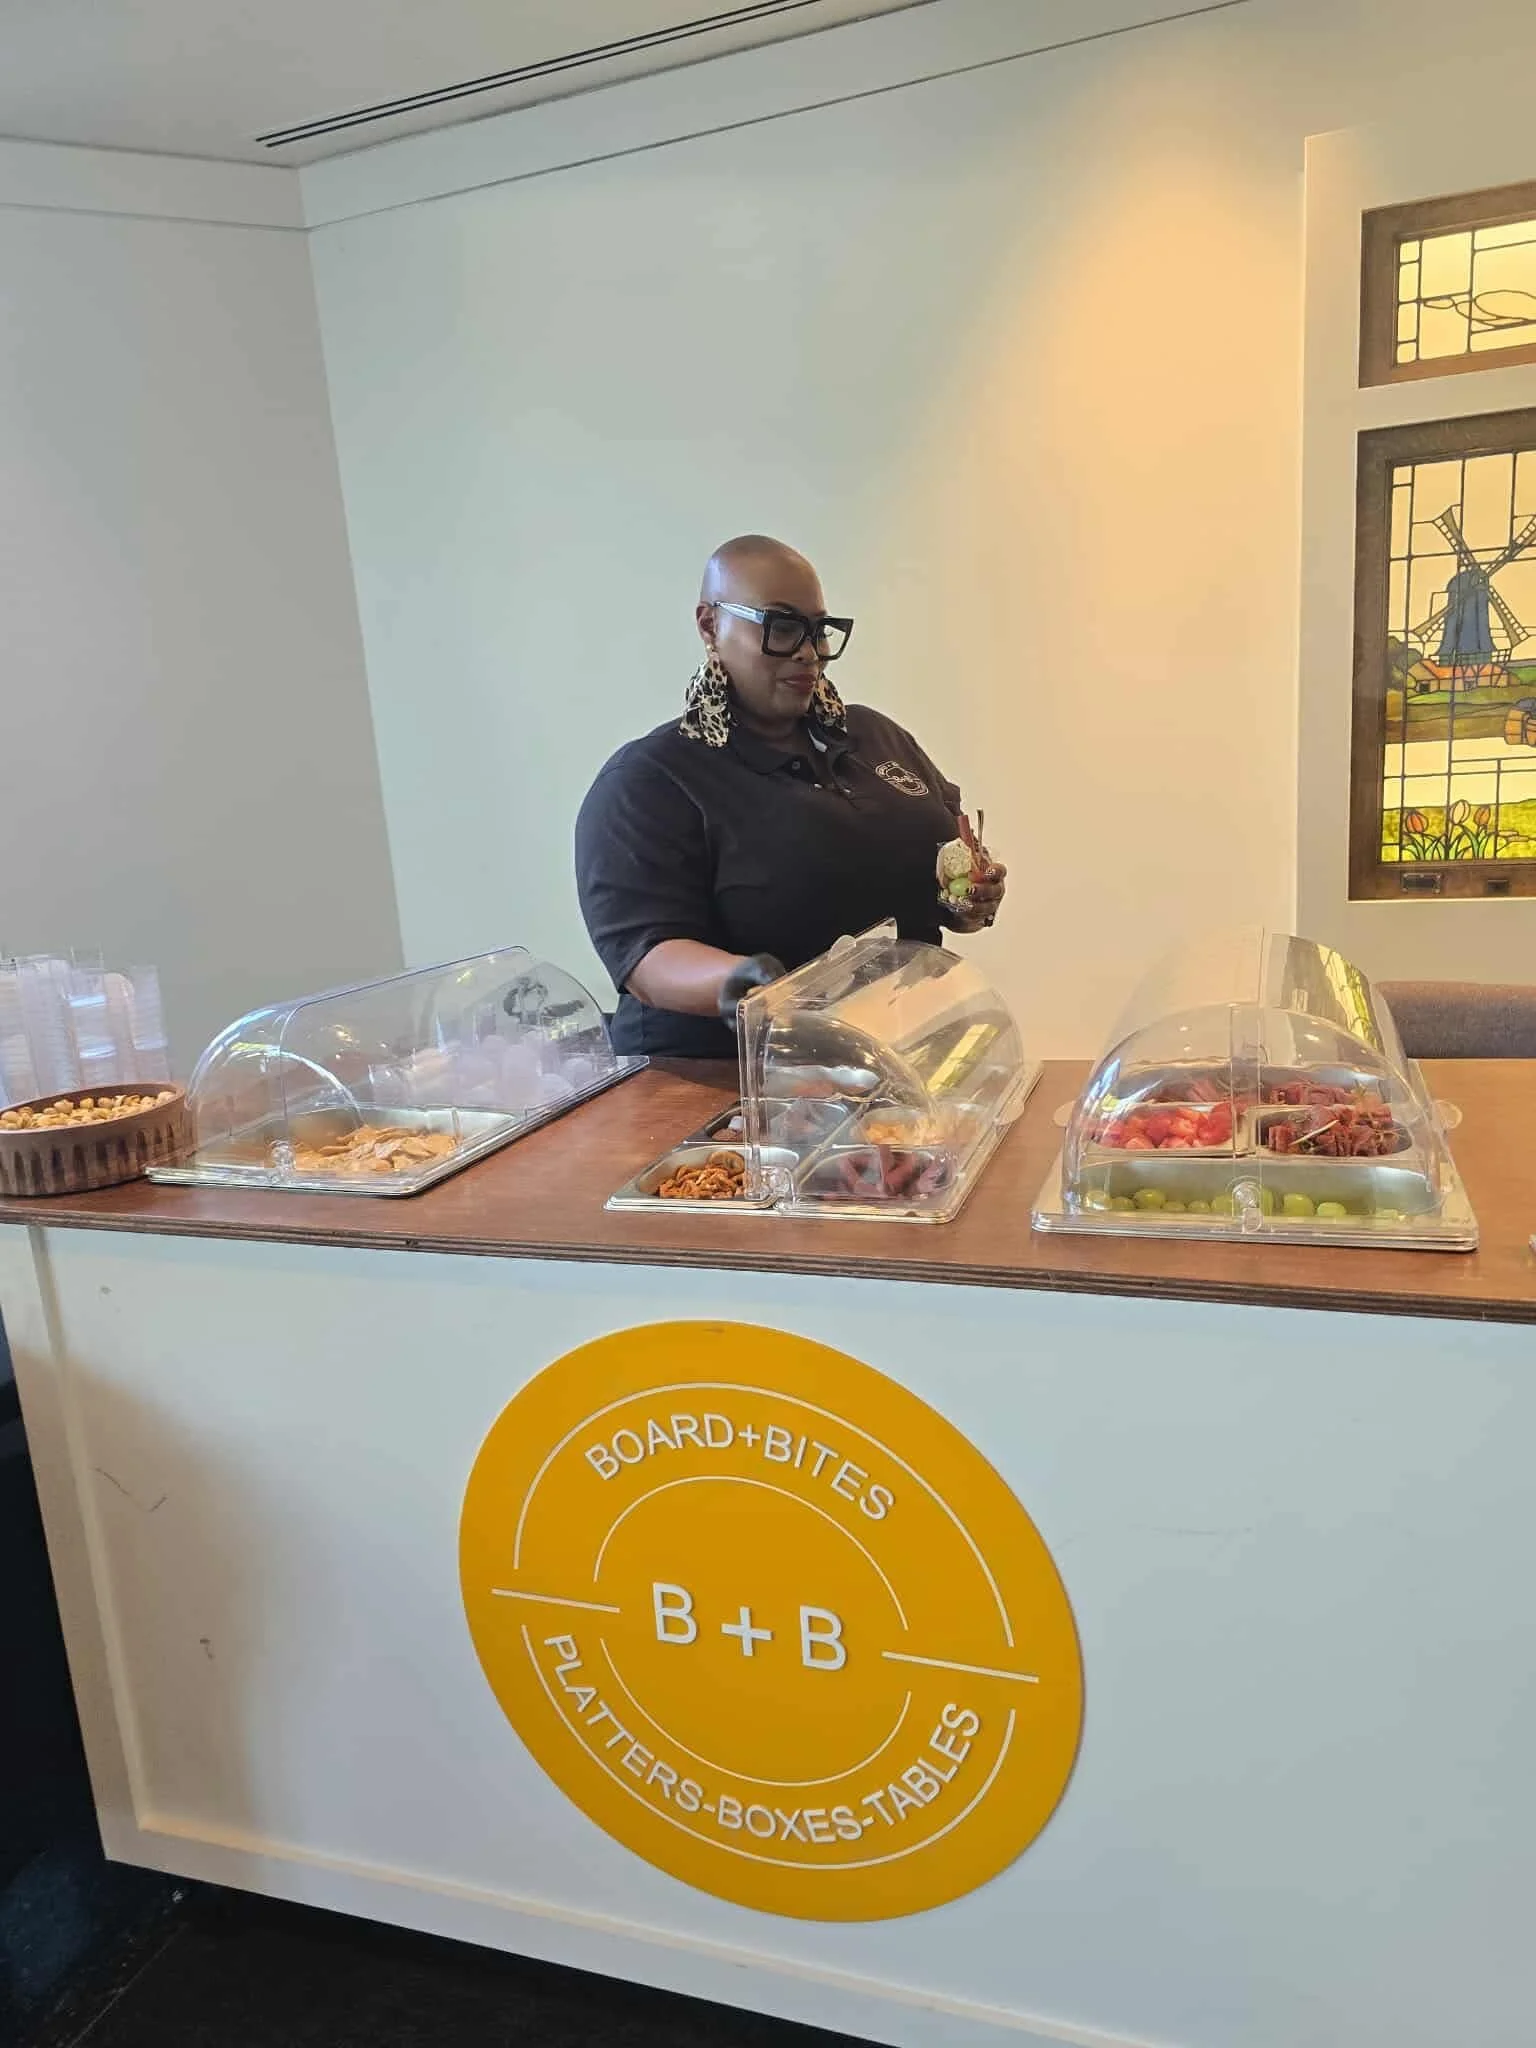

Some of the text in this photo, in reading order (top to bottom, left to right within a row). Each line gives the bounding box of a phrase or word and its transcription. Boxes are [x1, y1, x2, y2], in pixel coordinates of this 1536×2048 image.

[585, 1413, 894, 1520] BOARD+BITES
[653, 1583, 698, 1645] B
[800, 1605, 848, 1671] B
[544, 1634, 980, 1844] PLATTERS-BOXES-TABLES
